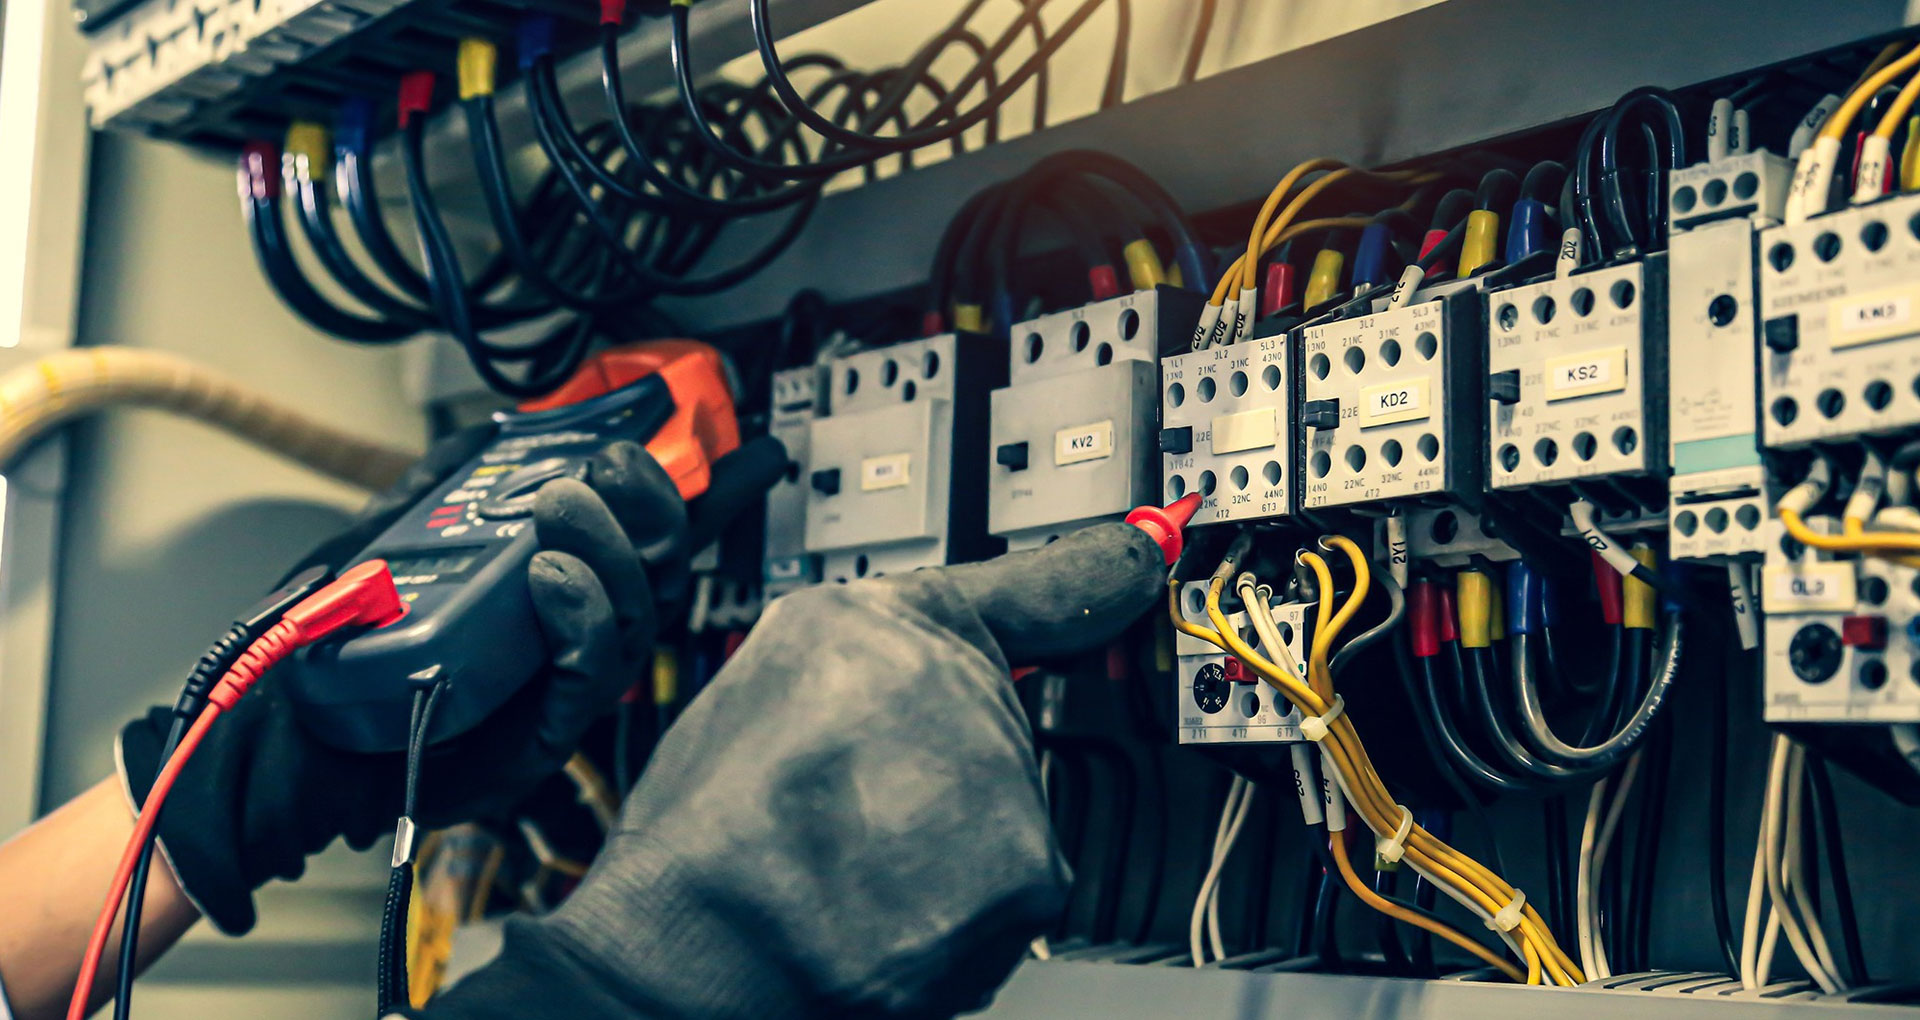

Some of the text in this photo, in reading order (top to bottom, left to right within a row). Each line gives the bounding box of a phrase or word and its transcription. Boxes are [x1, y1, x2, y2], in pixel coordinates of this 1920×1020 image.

[1412, 307, 1429, 318] 5L3
[1359, 318, 1375, 329] 3L2
[1310, 329, 1324, 339] 1L1
[1379, 327, 1400, 339] 31NC
[1260, 341, 1276, 351] 5L3
[1306, 341, 1326, 352] 13NO
[1342, 335, 1363, 347] 21NC
[1214, 350, 1229, 361] 3L2
[1262, 352, 1282, 363] 43NO
[1170, 359, 1183, 368] 1L1
[1230, 358, 1250, 370] 31NC
[1198, 364, 1217, 376] 21NC
[1567, 365, 1598, 381] KS2
[1380, 391, 1408, 408] KD2
[1342, 407, 1358, 419] 22E
[1071, 435, 1093, 449] KV2
[1195, 431, 1211, 443] 22E
[1308, 482, 1328, 494] 14NO
[1344, 478, 1365, 490] 22NC
[1232, 493, 1251, 504] 32NC
[1264, 489, 1284, 499] 44NO
[1365, 488, 1380, 498] 4T2
[1312, 496, 1327, 506] 2T1
[1261, 503, 1277, 512] 6T3
[1216, 509, 1230, 518] 4T2
